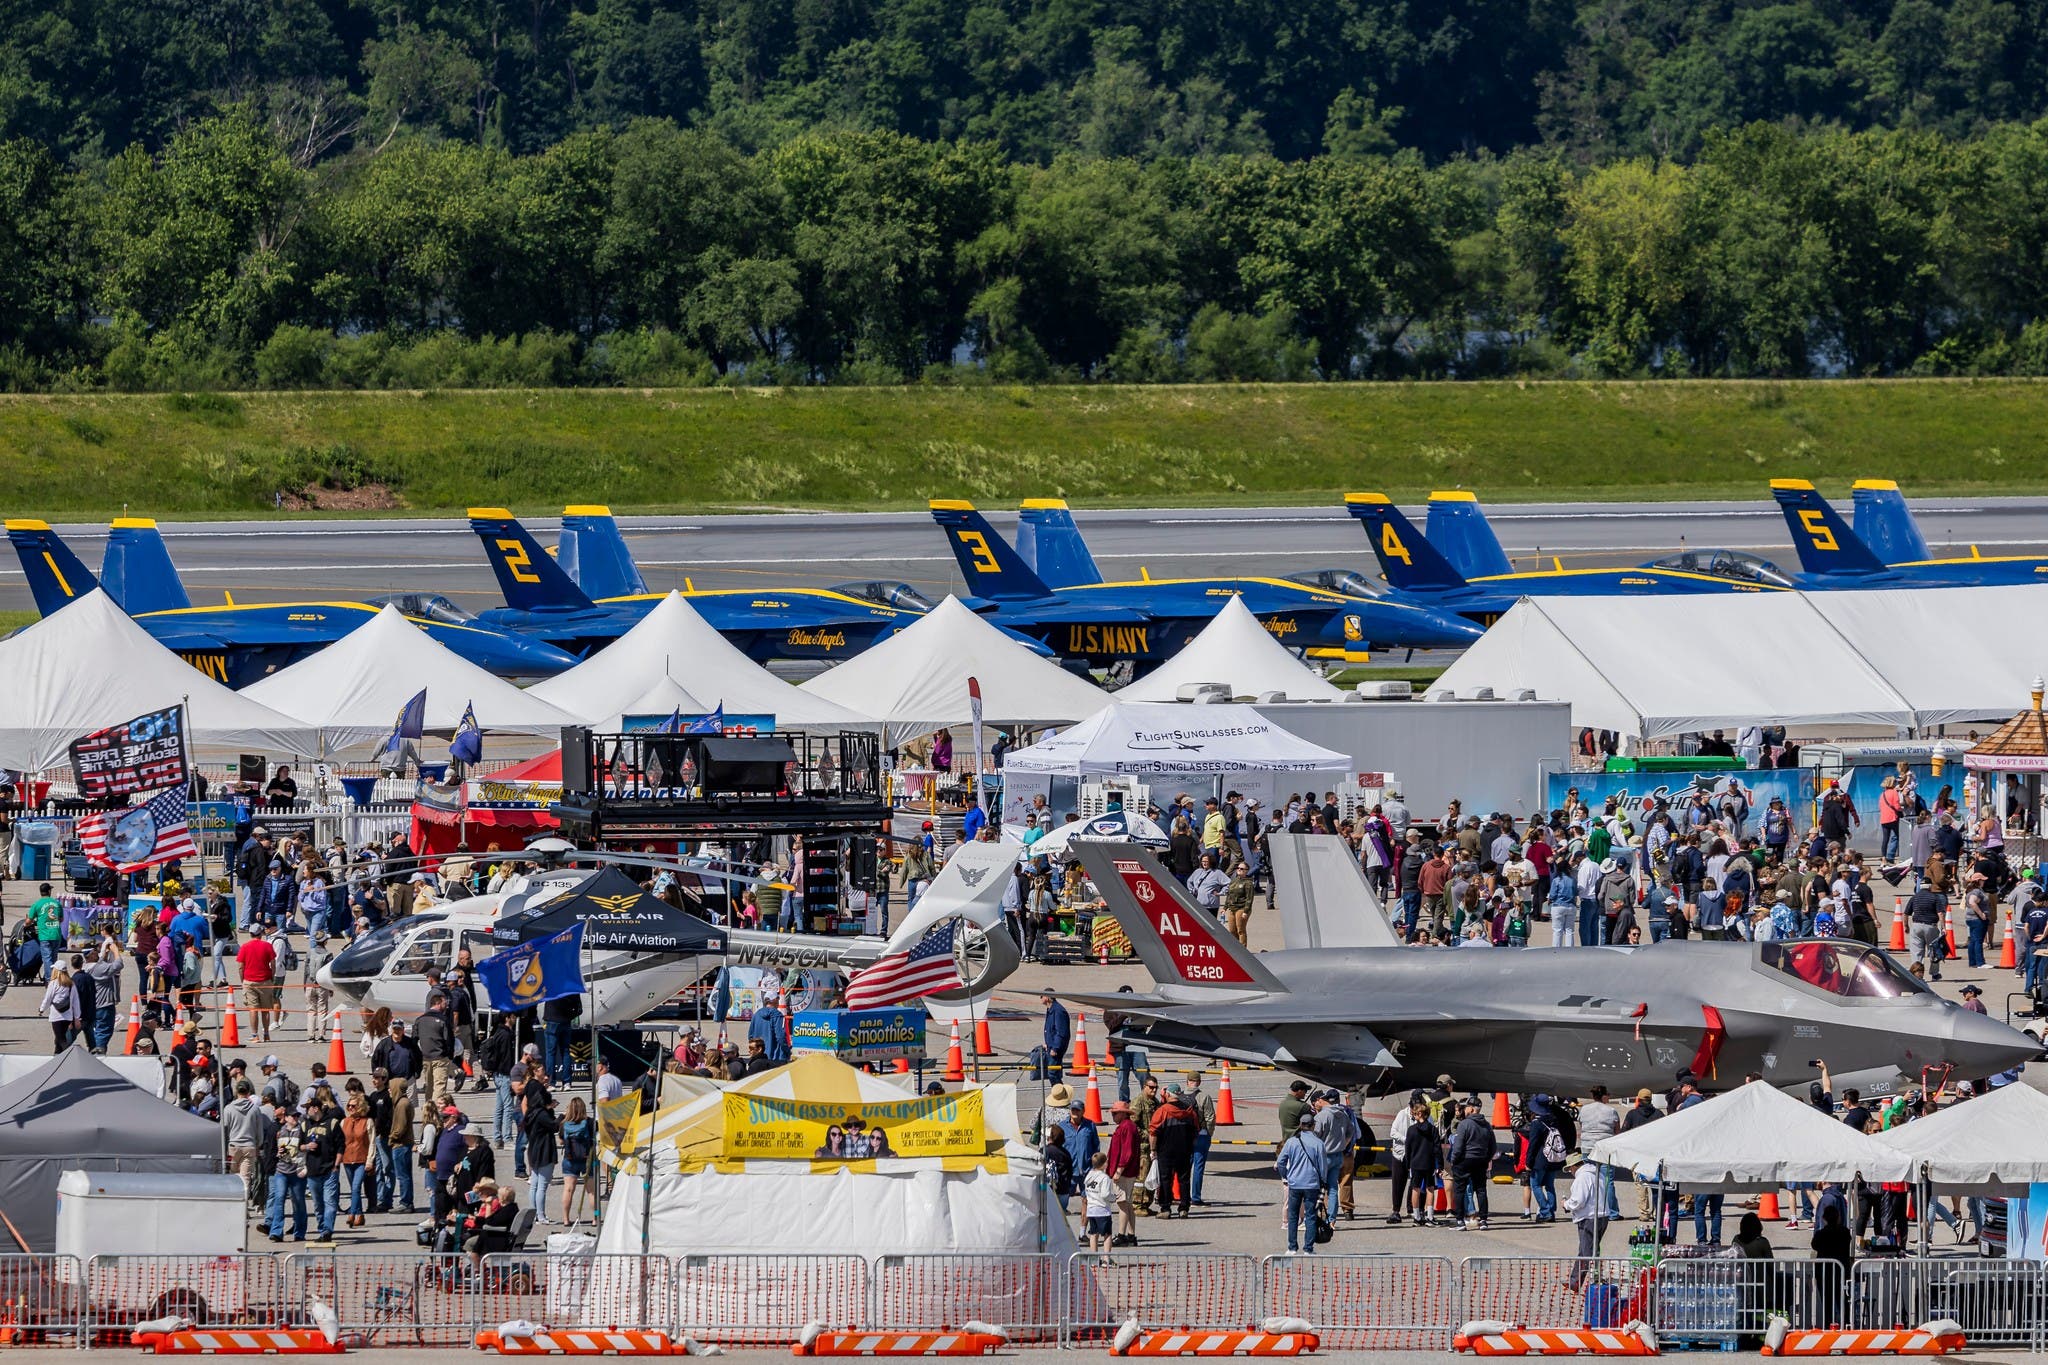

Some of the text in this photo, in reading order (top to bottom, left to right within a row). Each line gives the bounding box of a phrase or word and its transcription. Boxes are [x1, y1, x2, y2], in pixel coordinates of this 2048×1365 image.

[1797, 510, 1840, 550] 5
[1382, 523, 1413, 566] 4
[957, 531, 1002, 573] 3
[495, 539, 541, 583] 2
[42, 551, 75, 597] 1
[1265, 616, 1298, 638] Angels
[787, 629, 846, 651] Blue Angels
[884, 757, 889, 768] 6
[319, 766, 325, 776] 5
[477, 781, 564, 808] Blue Angel
[187, 817, 226, 829] oothies
[1117, 863, 1141, 871] ALABAMA
[576, 913, 664, 921] EAGLE AIR
[1160, 912, 1191, 937] AL
[582, 932, 677, 946] agle Air Aviation
[738, 943, 829, 968] N145CA
[1179, 944, 1216, 958] 187 FW
[1194, 965, 1224, 979] 5420
[793, 1027, 837, 1038] Smoothies
[849, 1026, 916, 1047] Smoothies
[1870, 1082, 1890, 1093] 5420
[749, 1096, 958, 1125] SUNGLASSES UNLIMITED
[748, 1131, 775, 1139] POLARIZED
[912, 1130, 942, 1139] PROTECTION
[948, 1129, 974, 1137] SUNBLOCK
[750, 1140, 771, 1148] DRIVERS
[945, 1137, 974, 1146] UMBRELLAS
